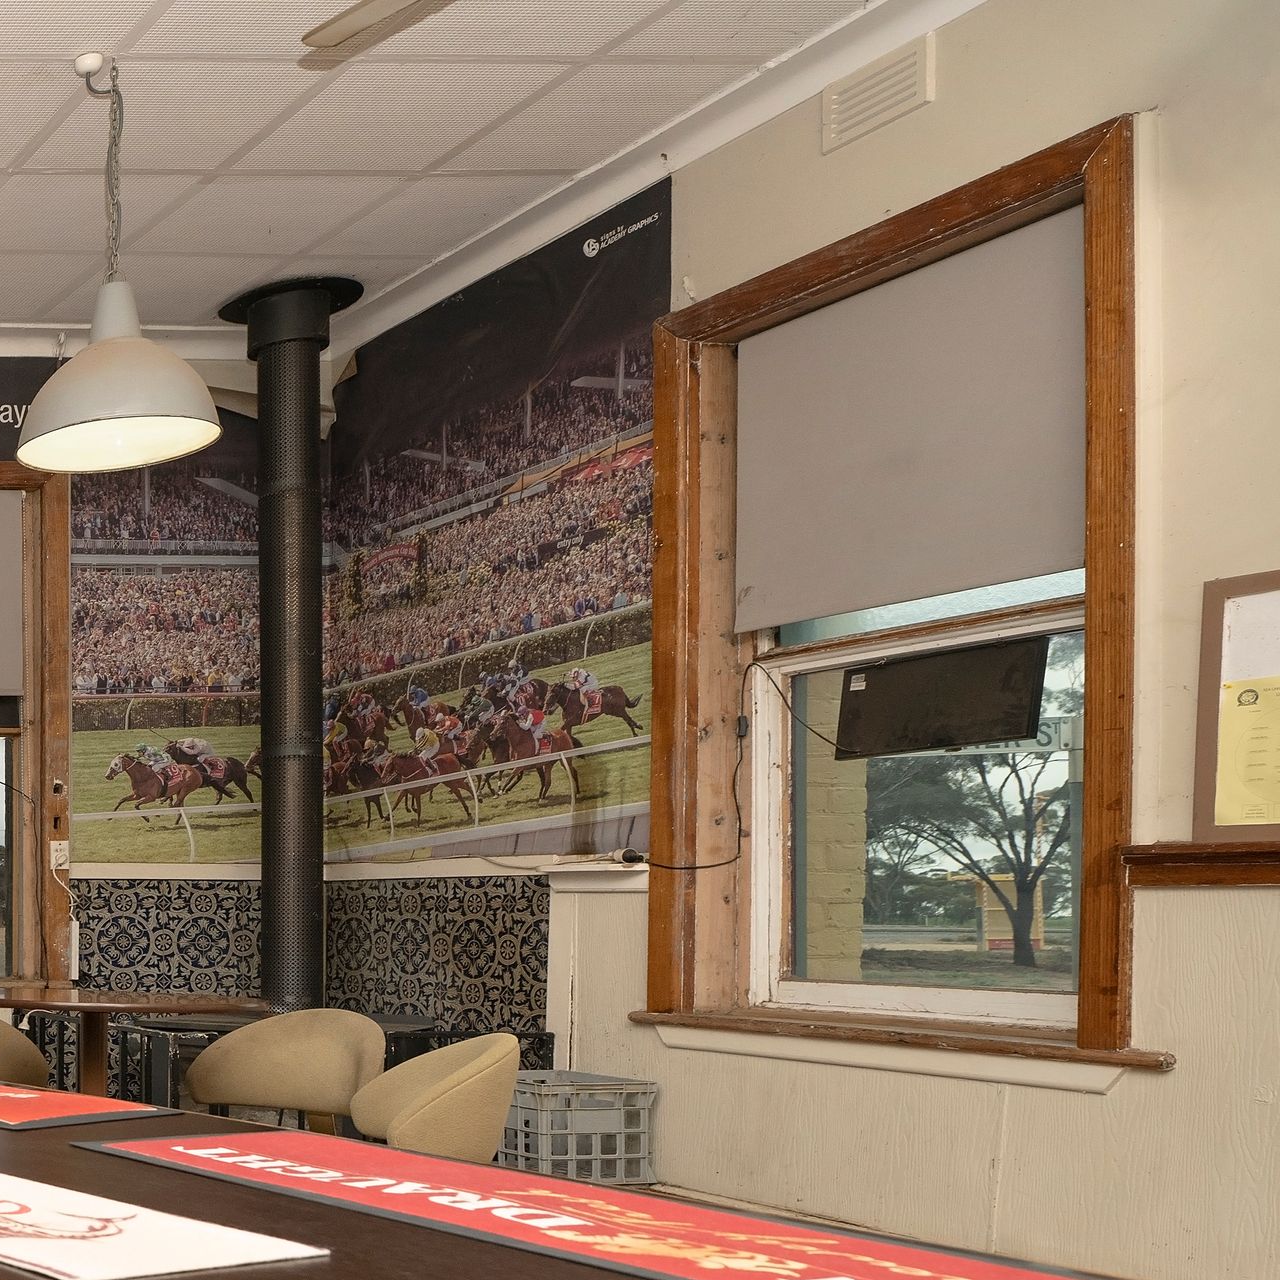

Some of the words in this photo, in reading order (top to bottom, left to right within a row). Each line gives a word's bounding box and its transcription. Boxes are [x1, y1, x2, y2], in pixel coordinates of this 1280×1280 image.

[600, 229, 628, 249] ACADEMY
[627, 212, 659, 234] GRAPHICS
[170, 1144, 594, 1232] DRAUGHT
